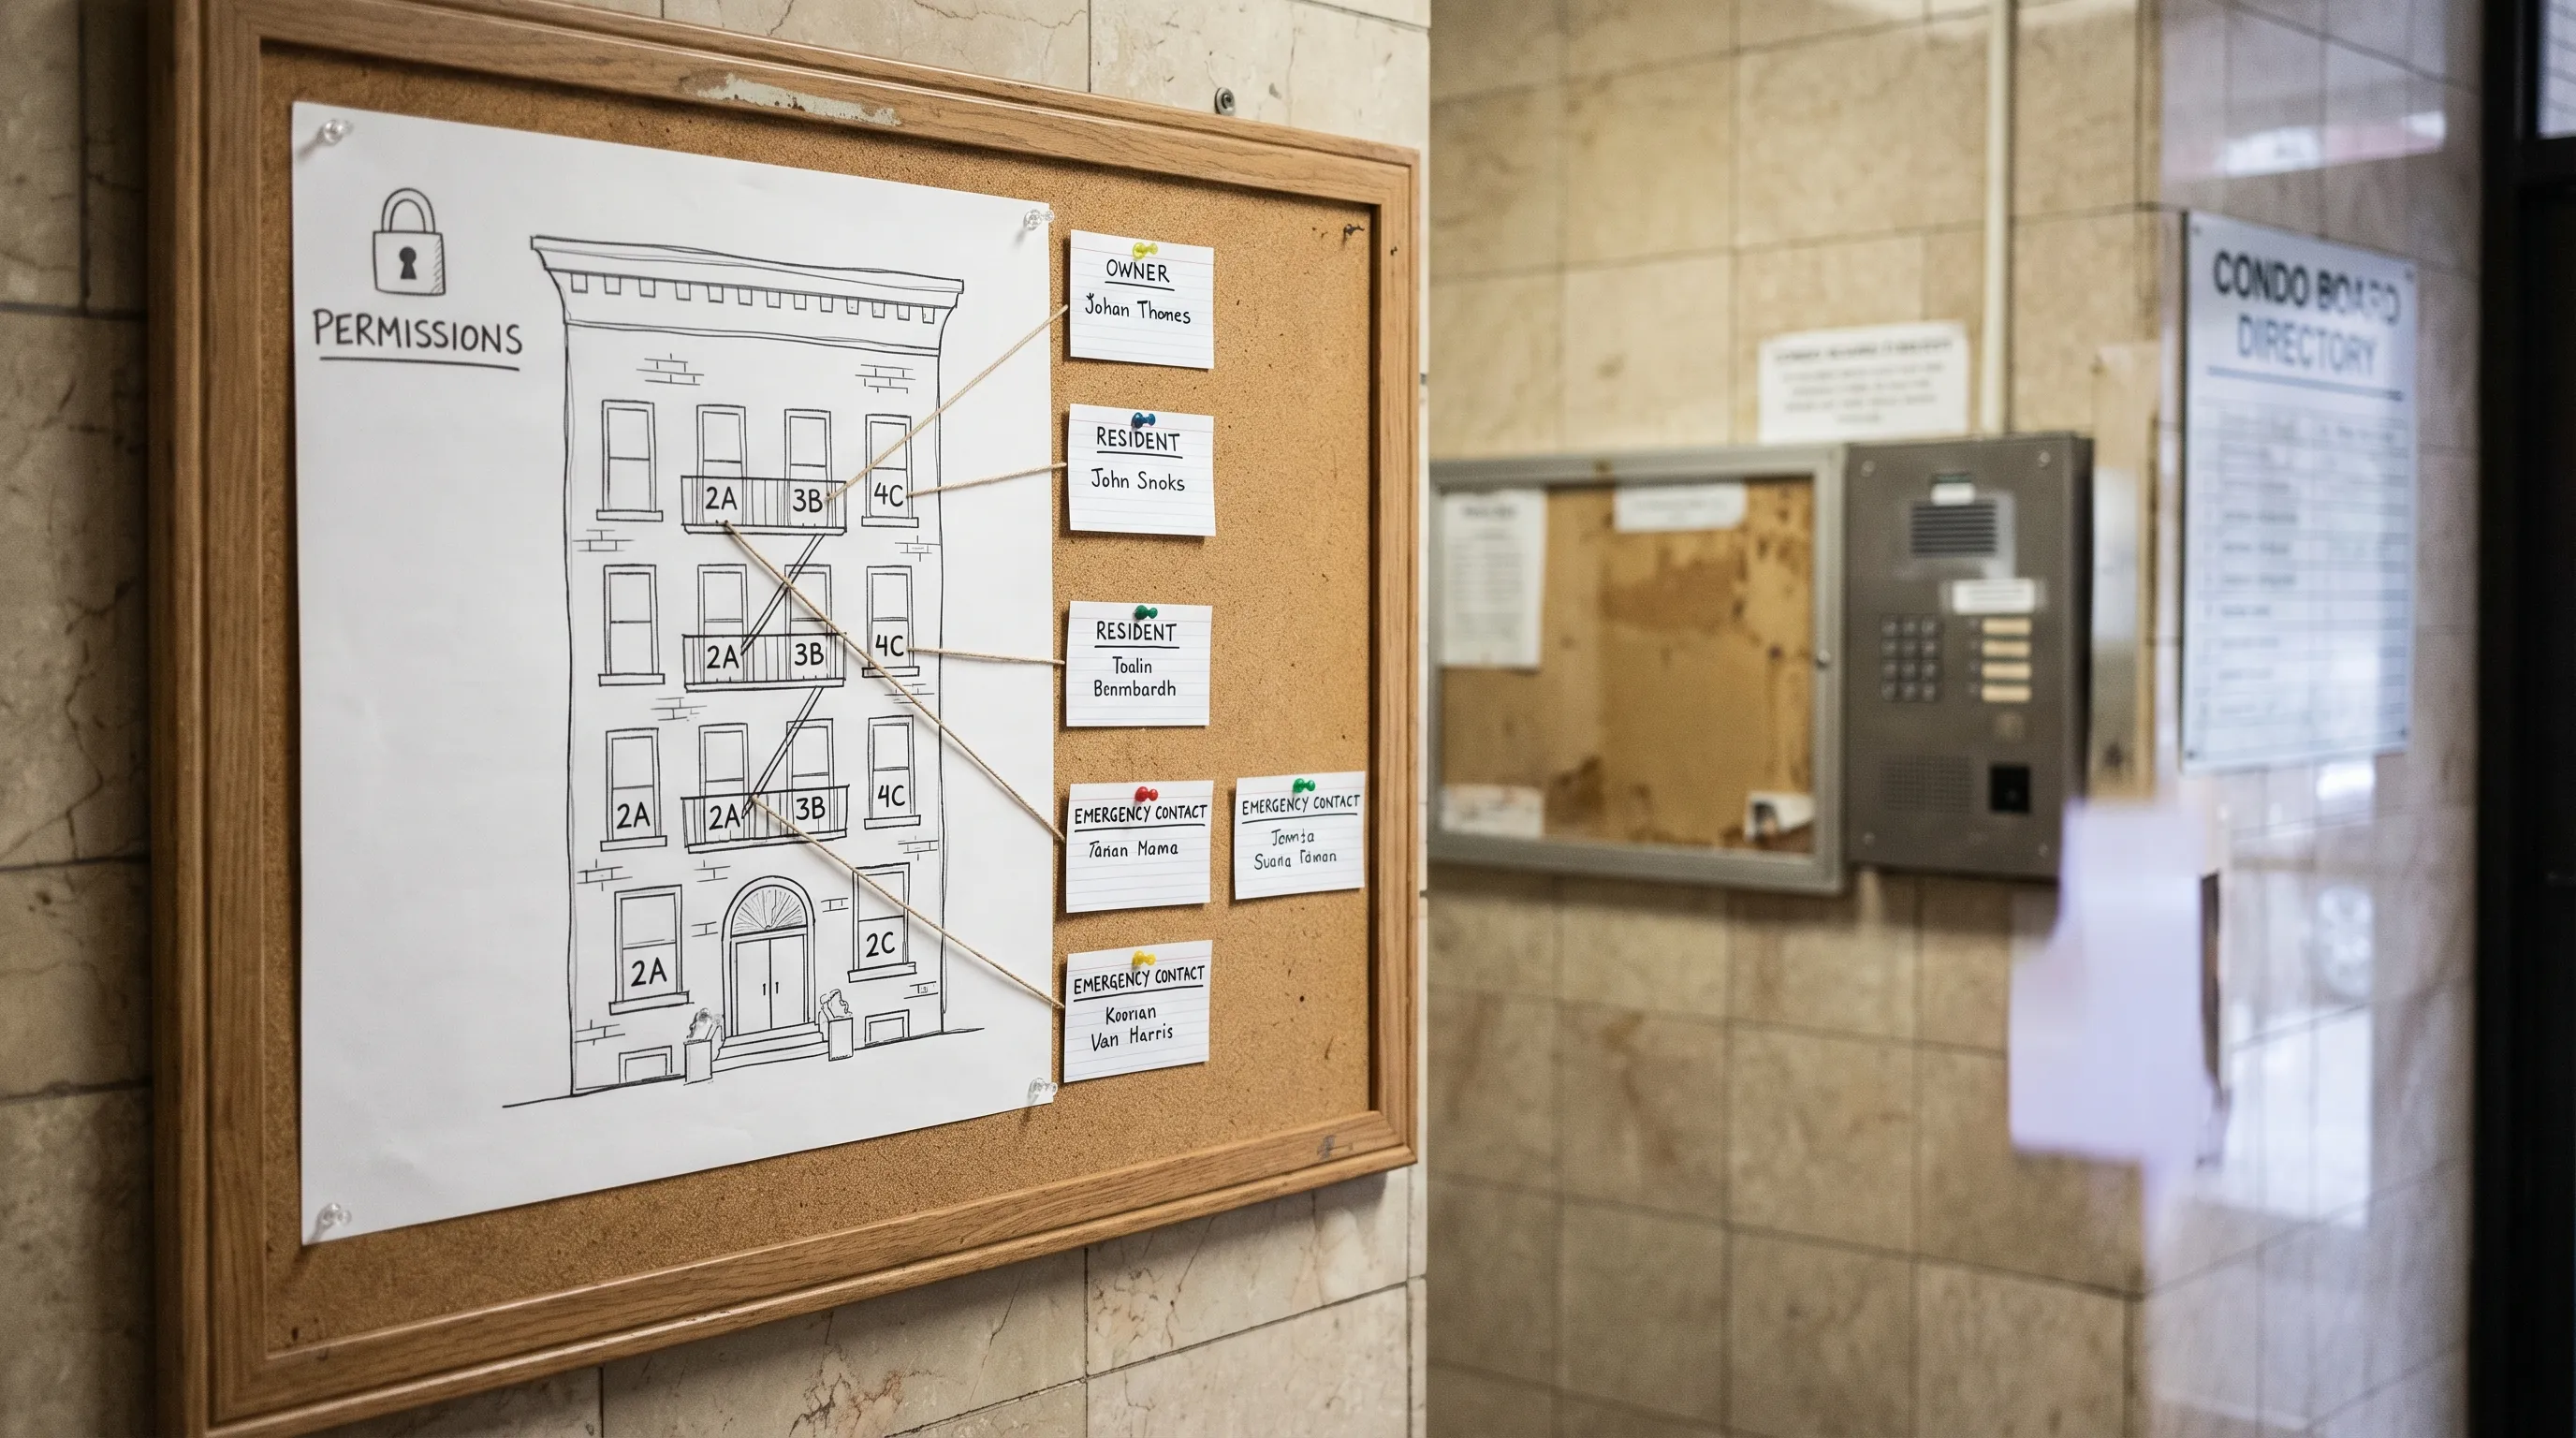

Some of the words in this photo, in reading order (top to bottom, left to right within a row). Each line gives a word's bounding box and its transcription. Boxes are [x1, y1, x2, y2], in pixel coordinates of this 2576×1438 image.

[1106, 258, 1170, 283] OWNER
[2213, 247, 2310, 309] CONDO
[2317, 266, 2402, 326] BOARD
[313, 308, 523, 355] PERMISSIONS
[2237, 312, 2377, 376] DIRECTORY
[1096, 426, 1180, 452] RESIDENT
[1090, 467, 1130, 488] John
[1137, 470, 1185, 492] Snoks
[705, 486, 738, 511] 2A
[792, 489, 824, 513] 3B
[873, 482, 904, 507] 4C
[1096, 621, 1178, 641] RESIDENT
[706, 645, 739, 669] 2A
[794, 641, 825, 666] 3B
[874, 635, 904, 657] 4C
[1112, 656, 1152, 674] Toalin
[877, 785, 906, 807] 4C
[1242, 796, 1309, 815] EMERGENCY
[1313, 794, 1360, 809] CONTACT
[616, 801, 651, 829] 2A
[709, 804, 741, 830] 2A
[795, 797, 826, 821] 3B
[1075, 805, 1151, 824] EMERGENCY
[1155, 804, 1208, 820] CONTACT
[1138, 840, 1178, 856] Mama
[865, 931, 896, 957] 2C
[630, 957, 667, 987] 2A
[1074, 970, 1150, 994] EMERGENCY
[1155, 965, 1206, 984] CONTACT
[1091, 1033, 1119, 1051] Van
[1130, 1023, 1173, 1044] Harris
